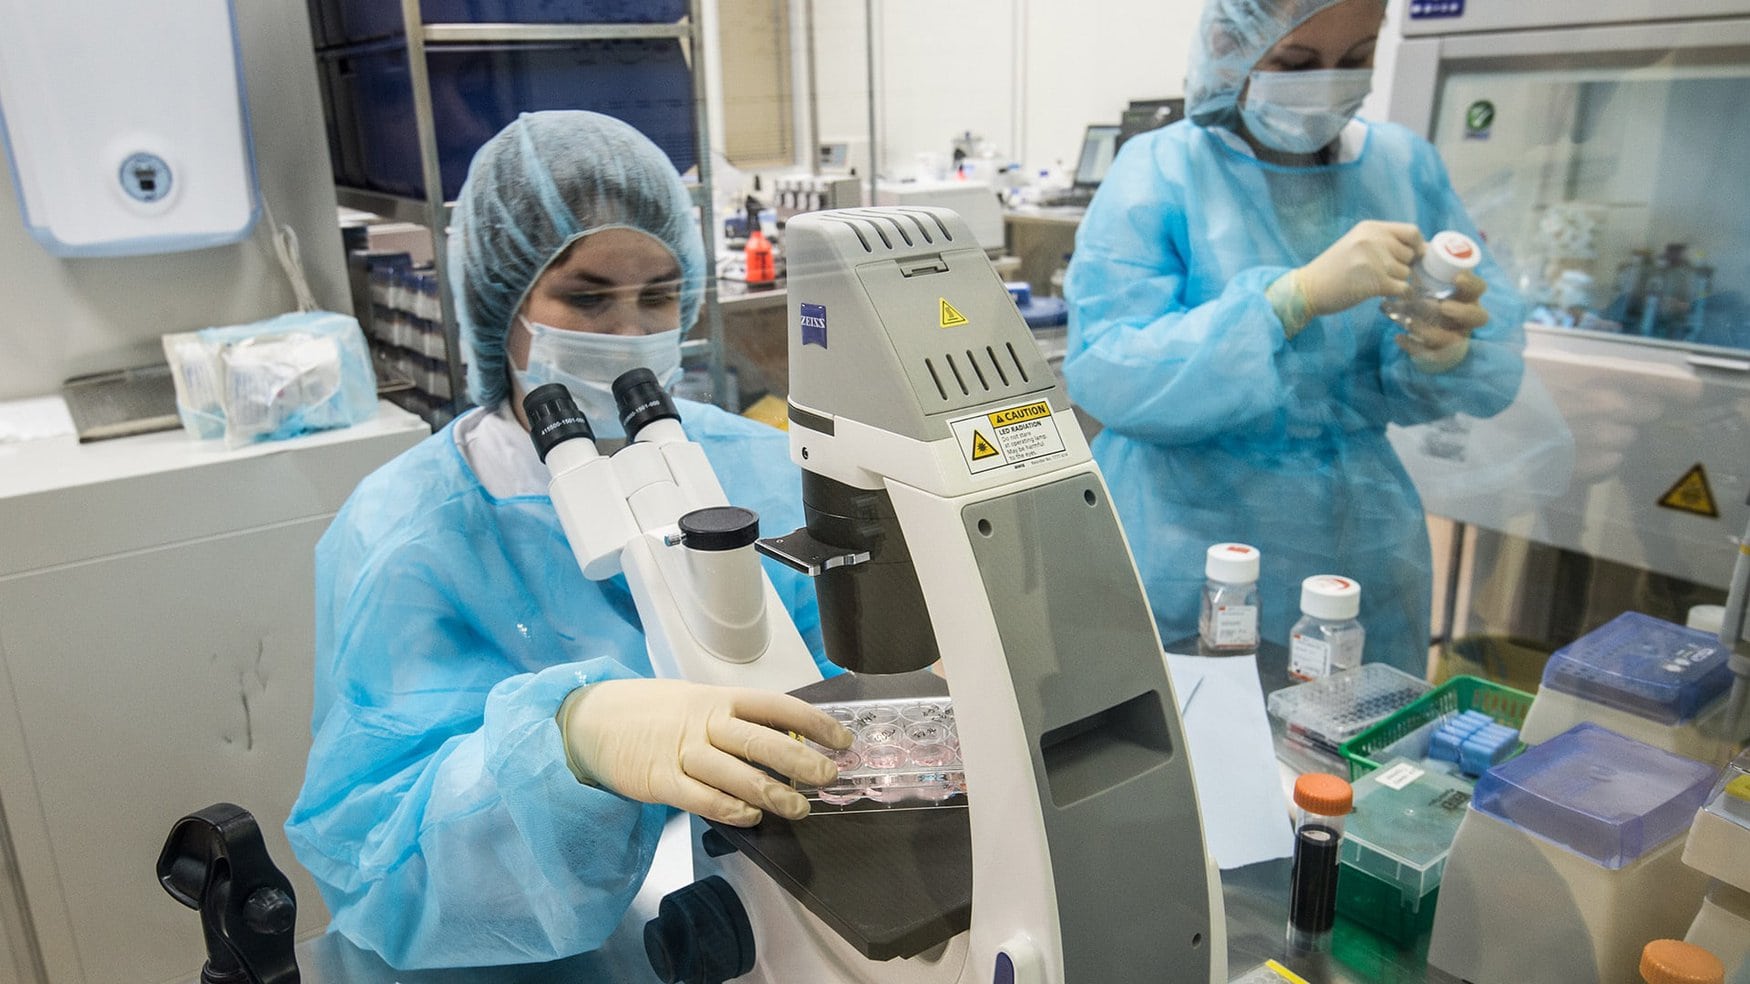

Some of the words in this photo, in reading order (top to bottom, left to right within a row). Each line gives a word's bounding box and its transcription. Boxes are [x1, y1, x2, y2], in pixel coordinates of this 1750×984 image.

[800, 315, 825, 328] ZEISS
[1004, 405, 1047, 421] CAUTION
[998, 427, 1010, 435] LED
[1010, 421, 1042, 432] RADIATION
